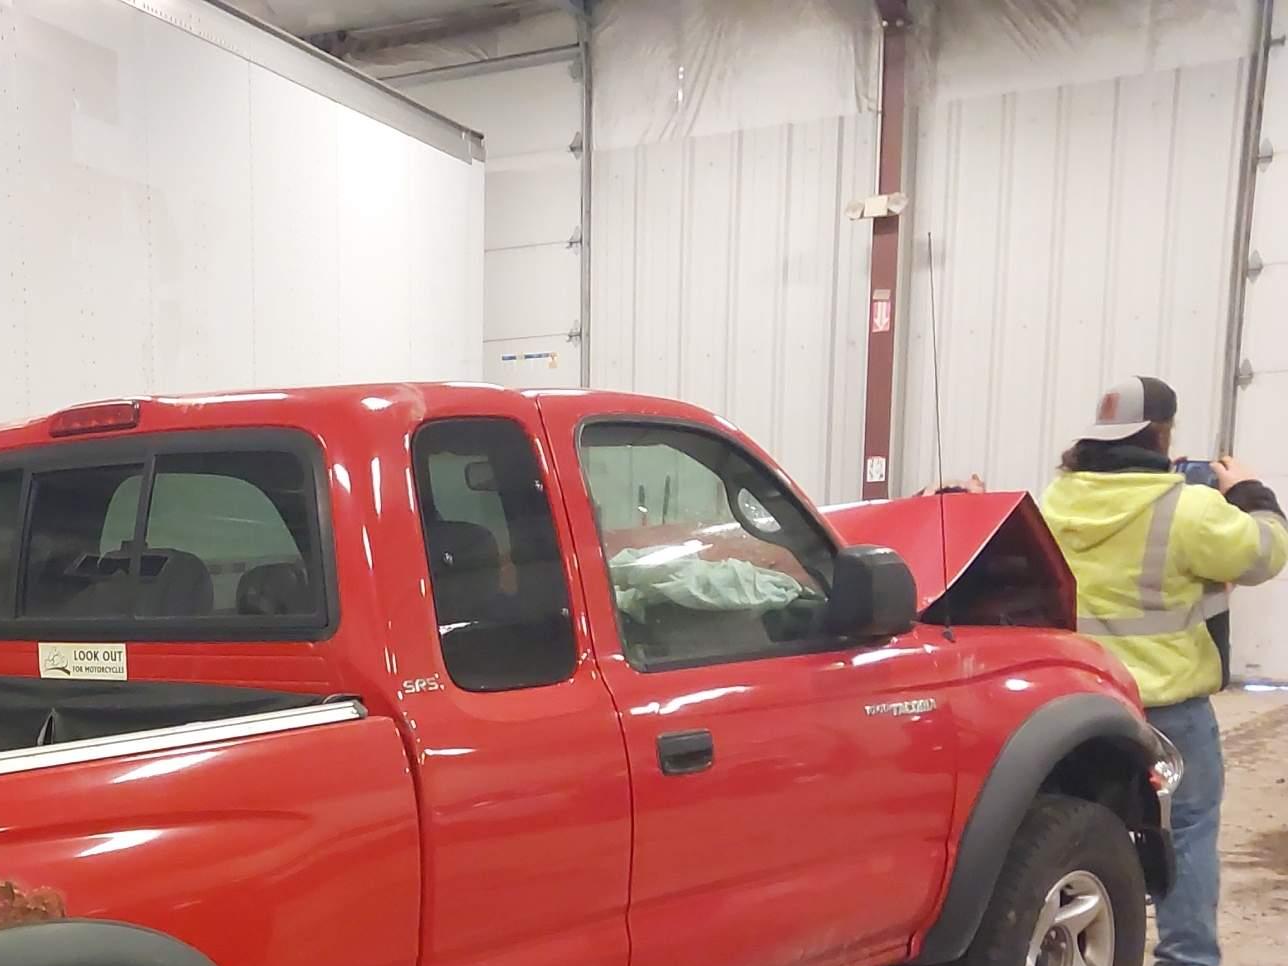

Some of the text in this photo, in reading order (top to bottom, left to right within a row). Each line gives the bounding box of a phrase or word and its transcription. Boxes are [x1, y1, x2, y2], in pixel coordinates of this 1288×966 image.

[73, 650, 124, 662] LOOK OUT
[72, 665, 125, 674] FOR MOTORCYCLES
